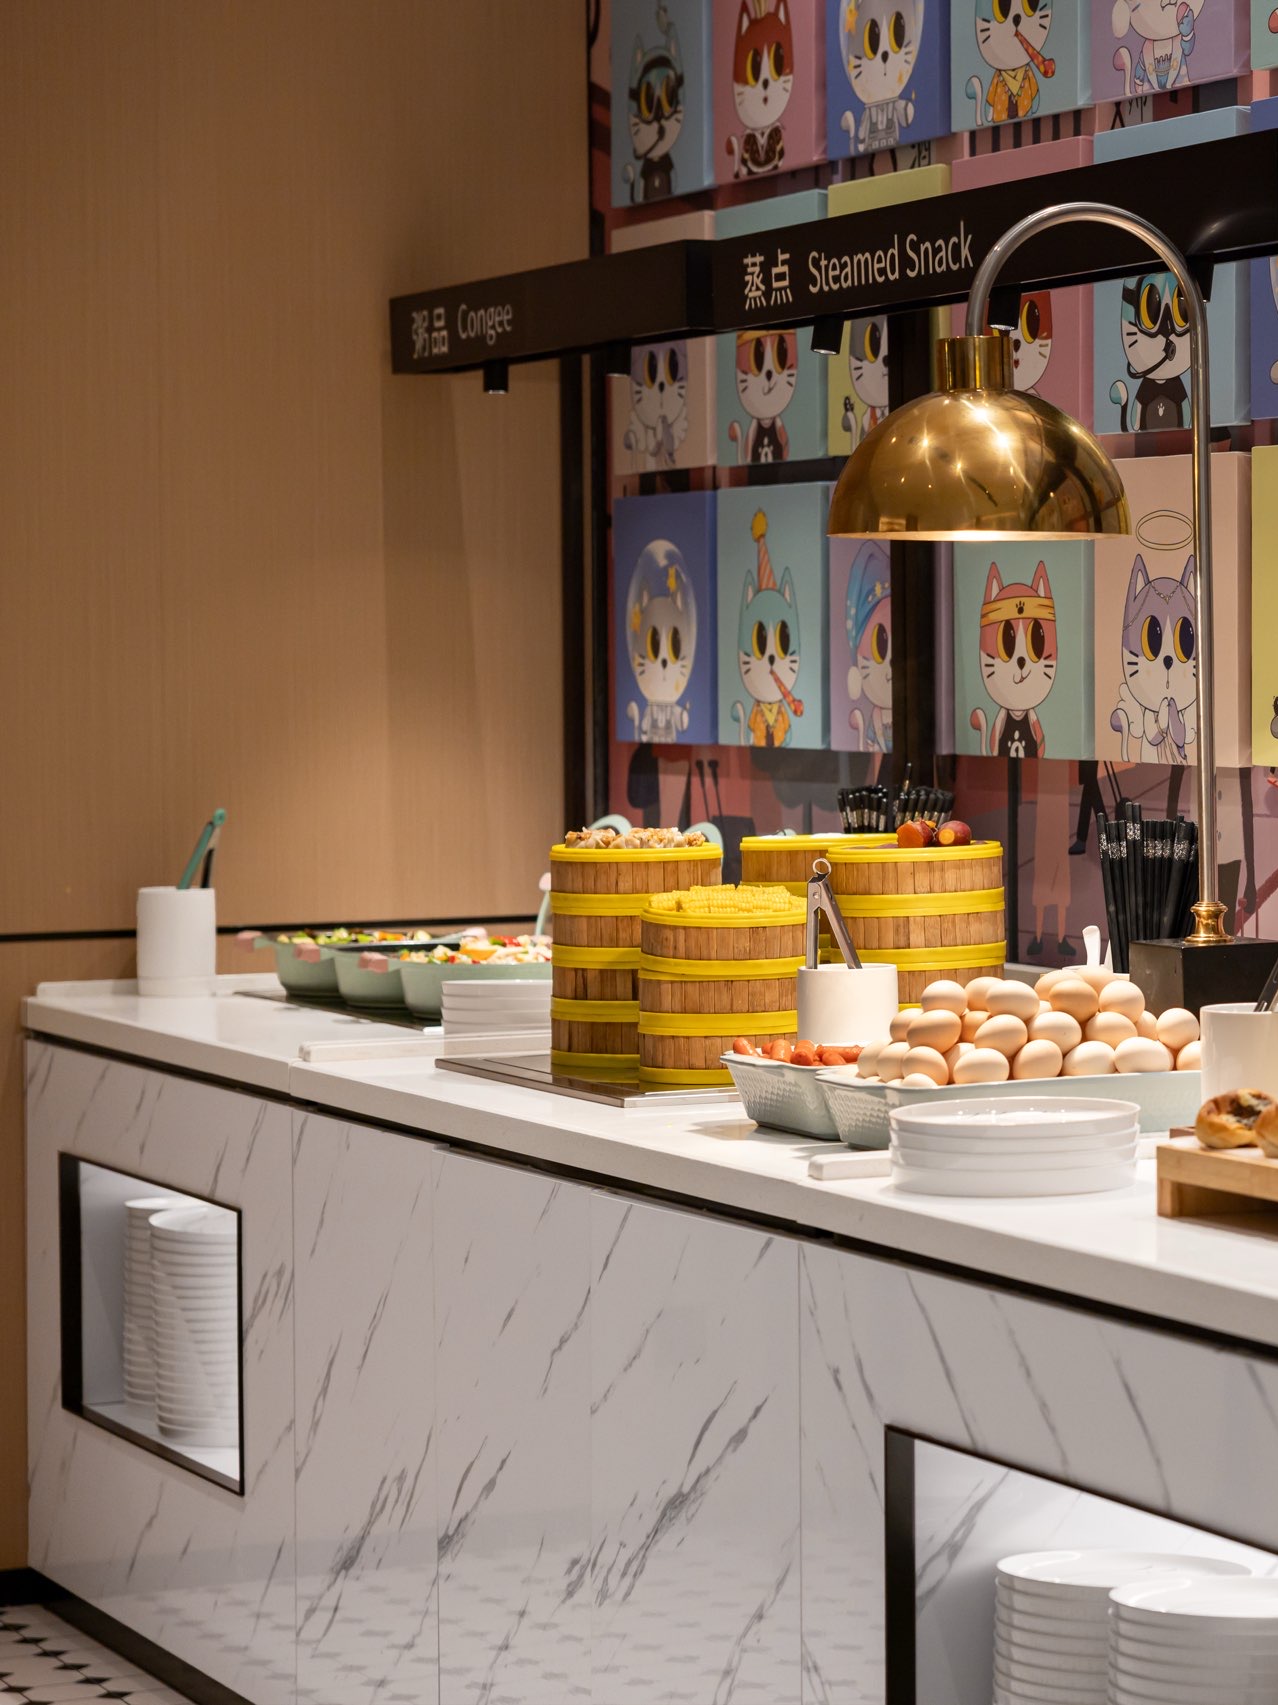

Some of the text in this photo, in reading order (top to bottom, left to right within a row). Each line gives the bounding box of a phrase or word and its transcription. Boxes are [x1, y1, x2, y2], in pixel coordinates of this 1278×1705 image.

[743, 220, 974, 311] 蒸点 Steamed Snack
[411, 304, 513, 359] 粥品 Congee
